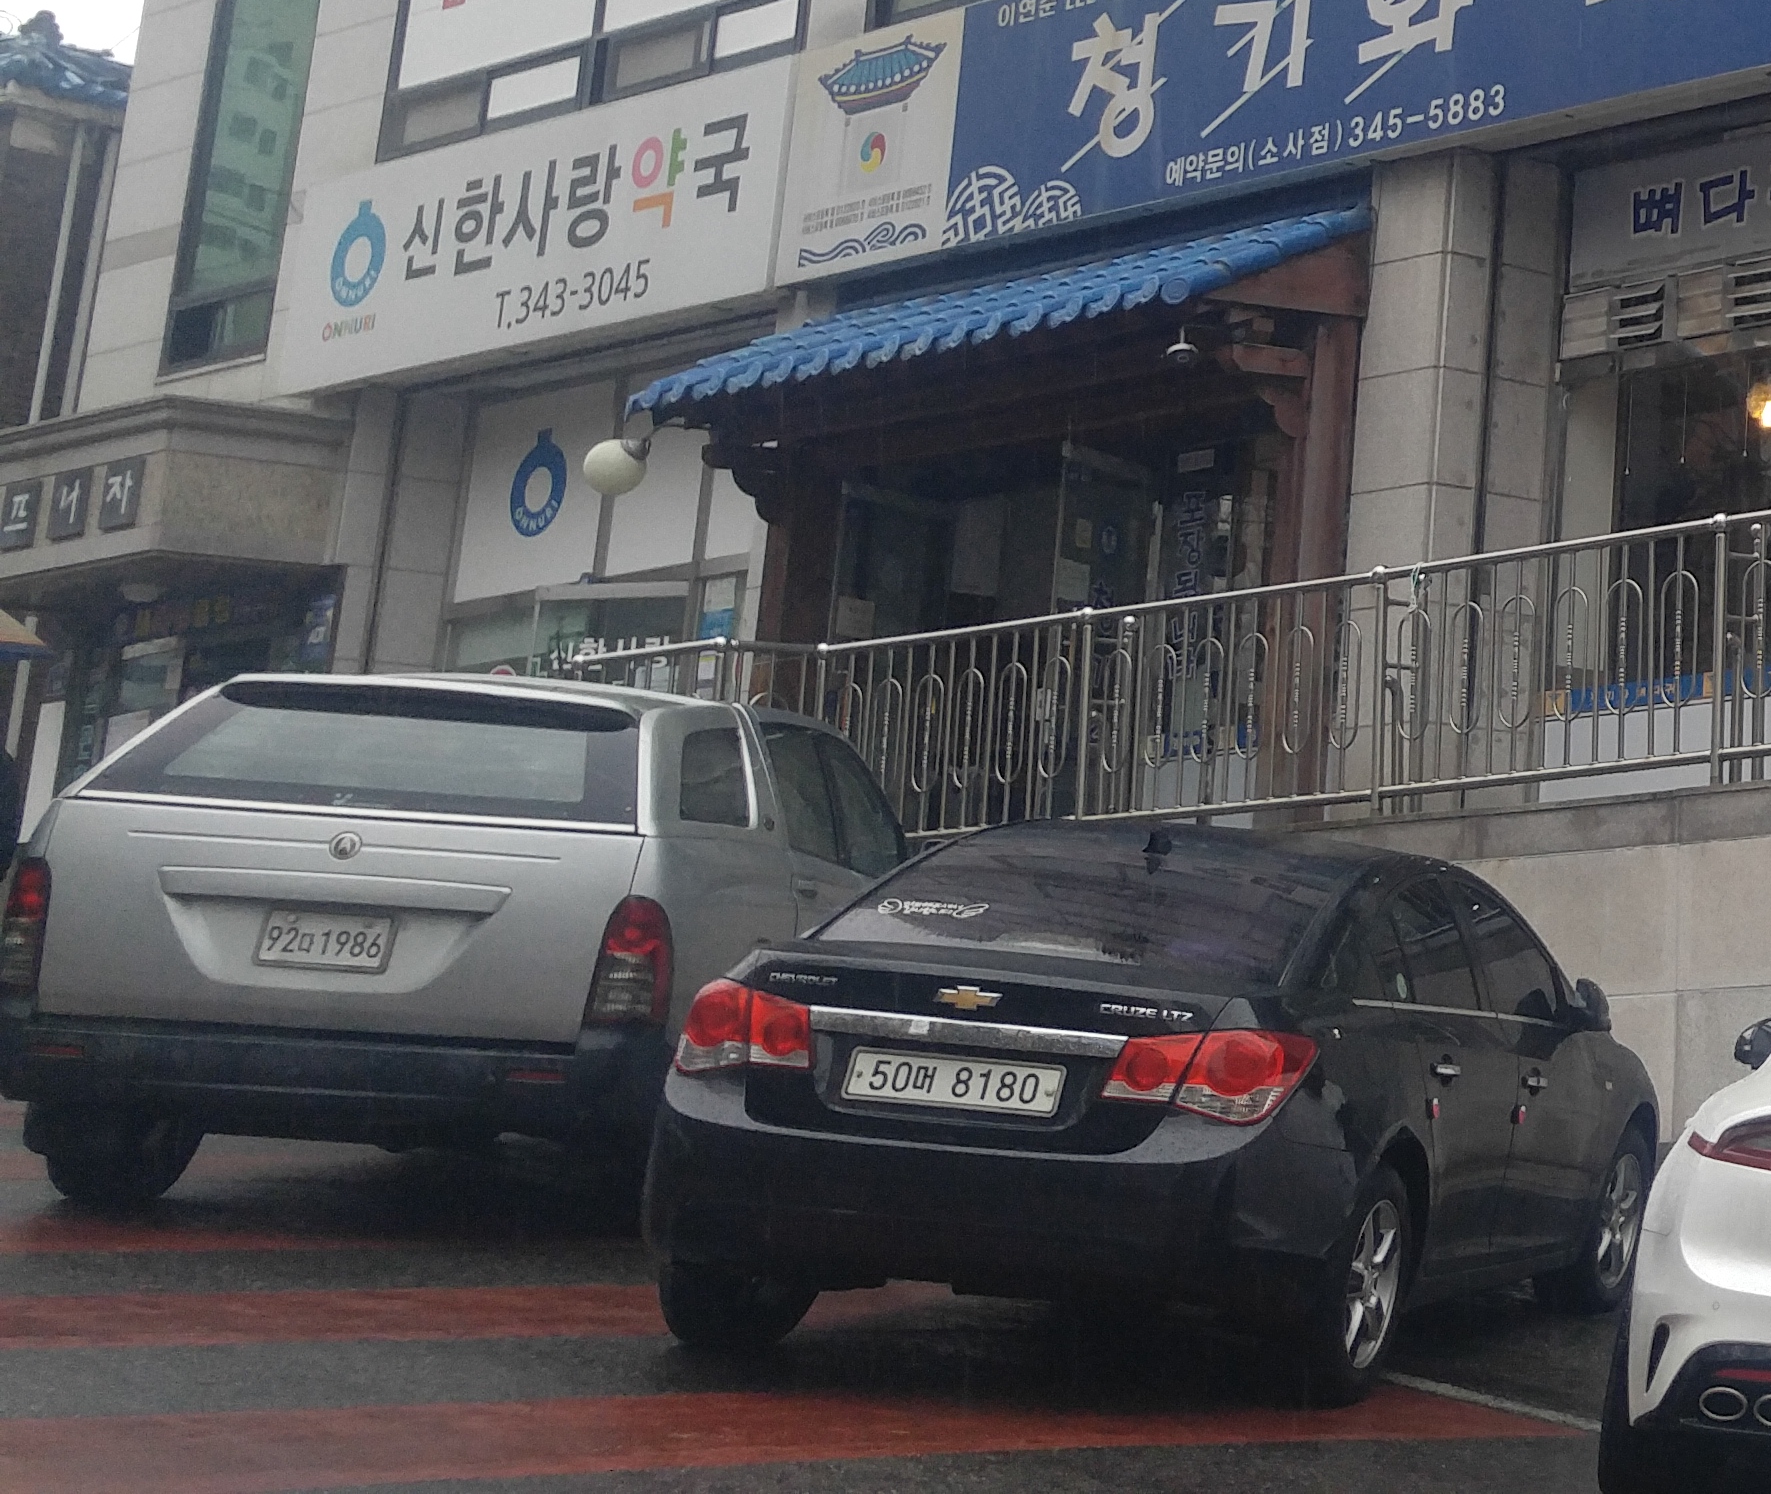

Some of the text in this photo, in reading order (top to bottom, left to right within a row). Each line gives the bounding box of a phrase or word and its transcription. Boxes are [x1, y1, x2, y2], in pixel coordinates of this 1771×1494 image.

[1349, 84, 1506, 147] 345-5883
[401, 113, 752, 280] 신한사랑약국
[493, 258, 651, 331] T.343-3045
[322, 313, 376, 342] ONNURI
[1099, 1000, 1195, 1023] CRUZE LTZ
